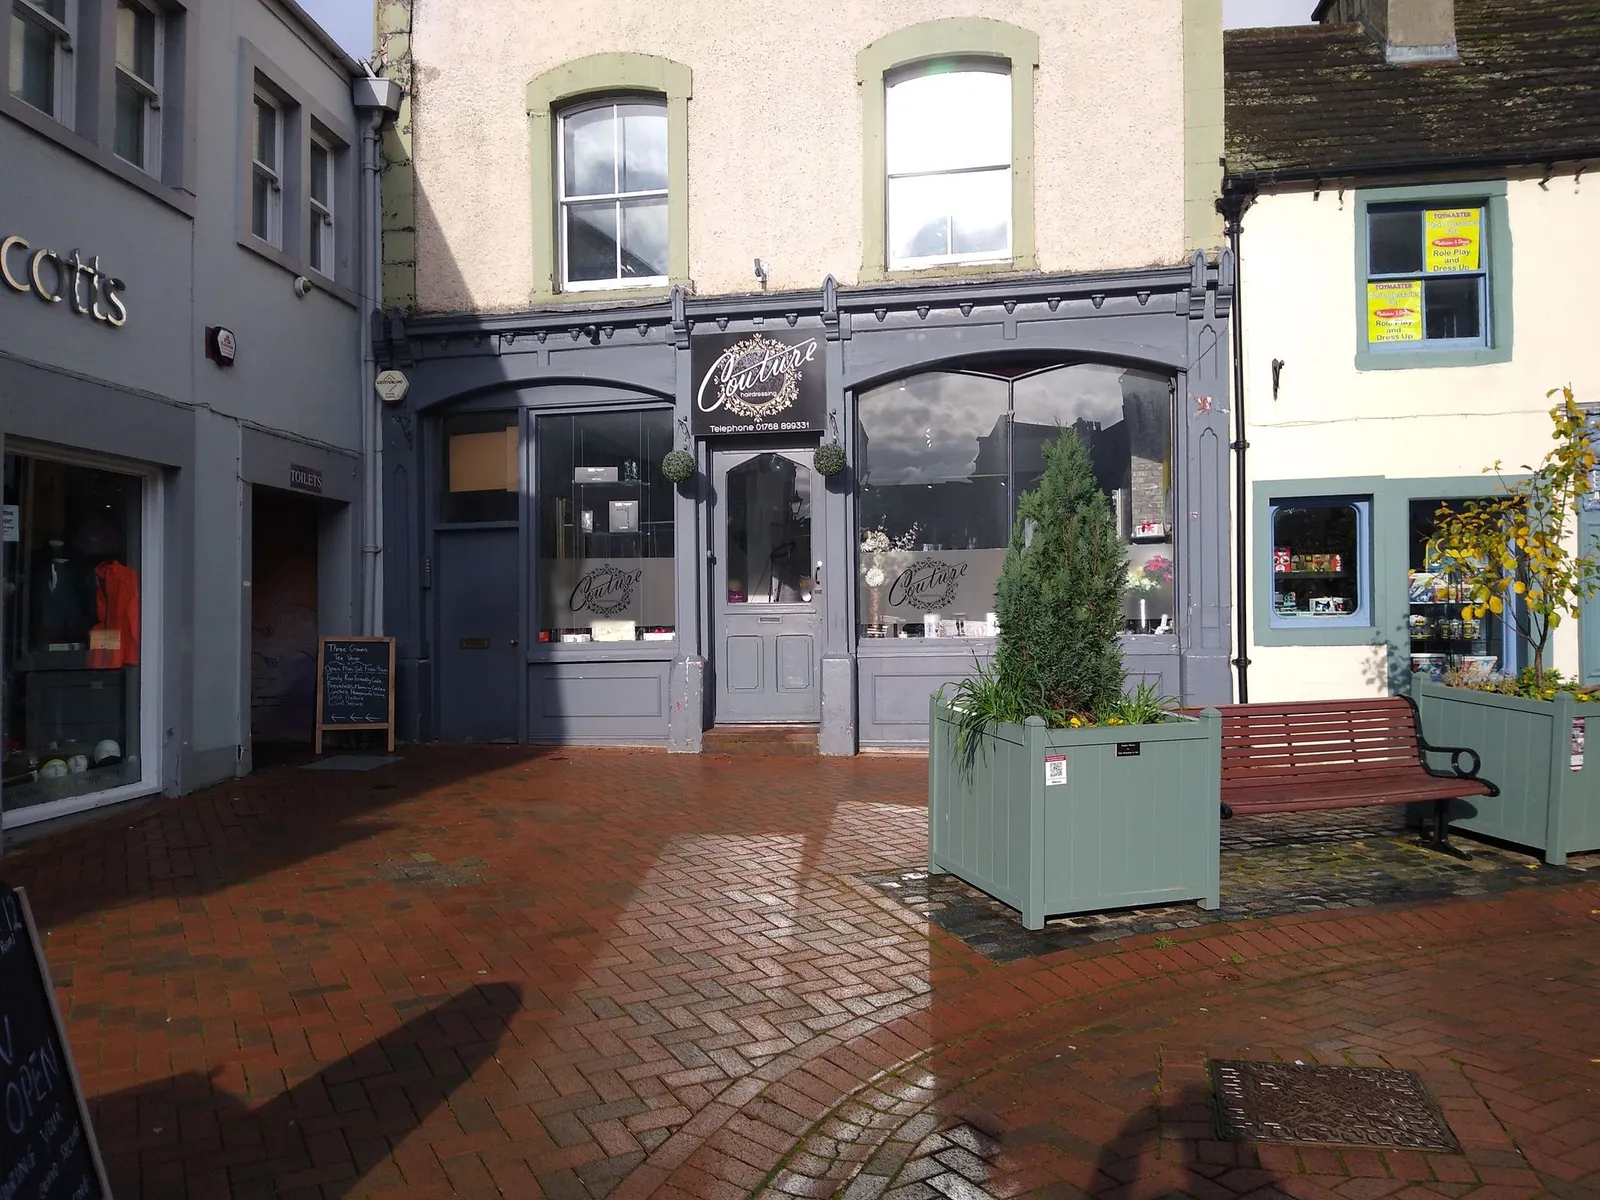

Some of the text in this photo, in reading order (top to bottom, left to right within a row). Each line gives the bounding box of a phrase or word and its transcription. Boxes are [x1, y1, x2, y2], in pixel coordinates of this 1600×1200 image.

[1454, 249, 1471, 257] Play
[697, 337, 818, 412] Couture
[740, 391, 778, 399] hairdressing
[710, 421, 810, 434] Telephone 01768 899331
[290, 468, 322, 489] TOILETS
[569, 568, 642, 612] Couture
[888, 560, 968, 607] Couture
[327, 644, 347, 652] Three
[333, 653, 344, 661] Tea
[5, 1038, 61, 1136] OPEN
